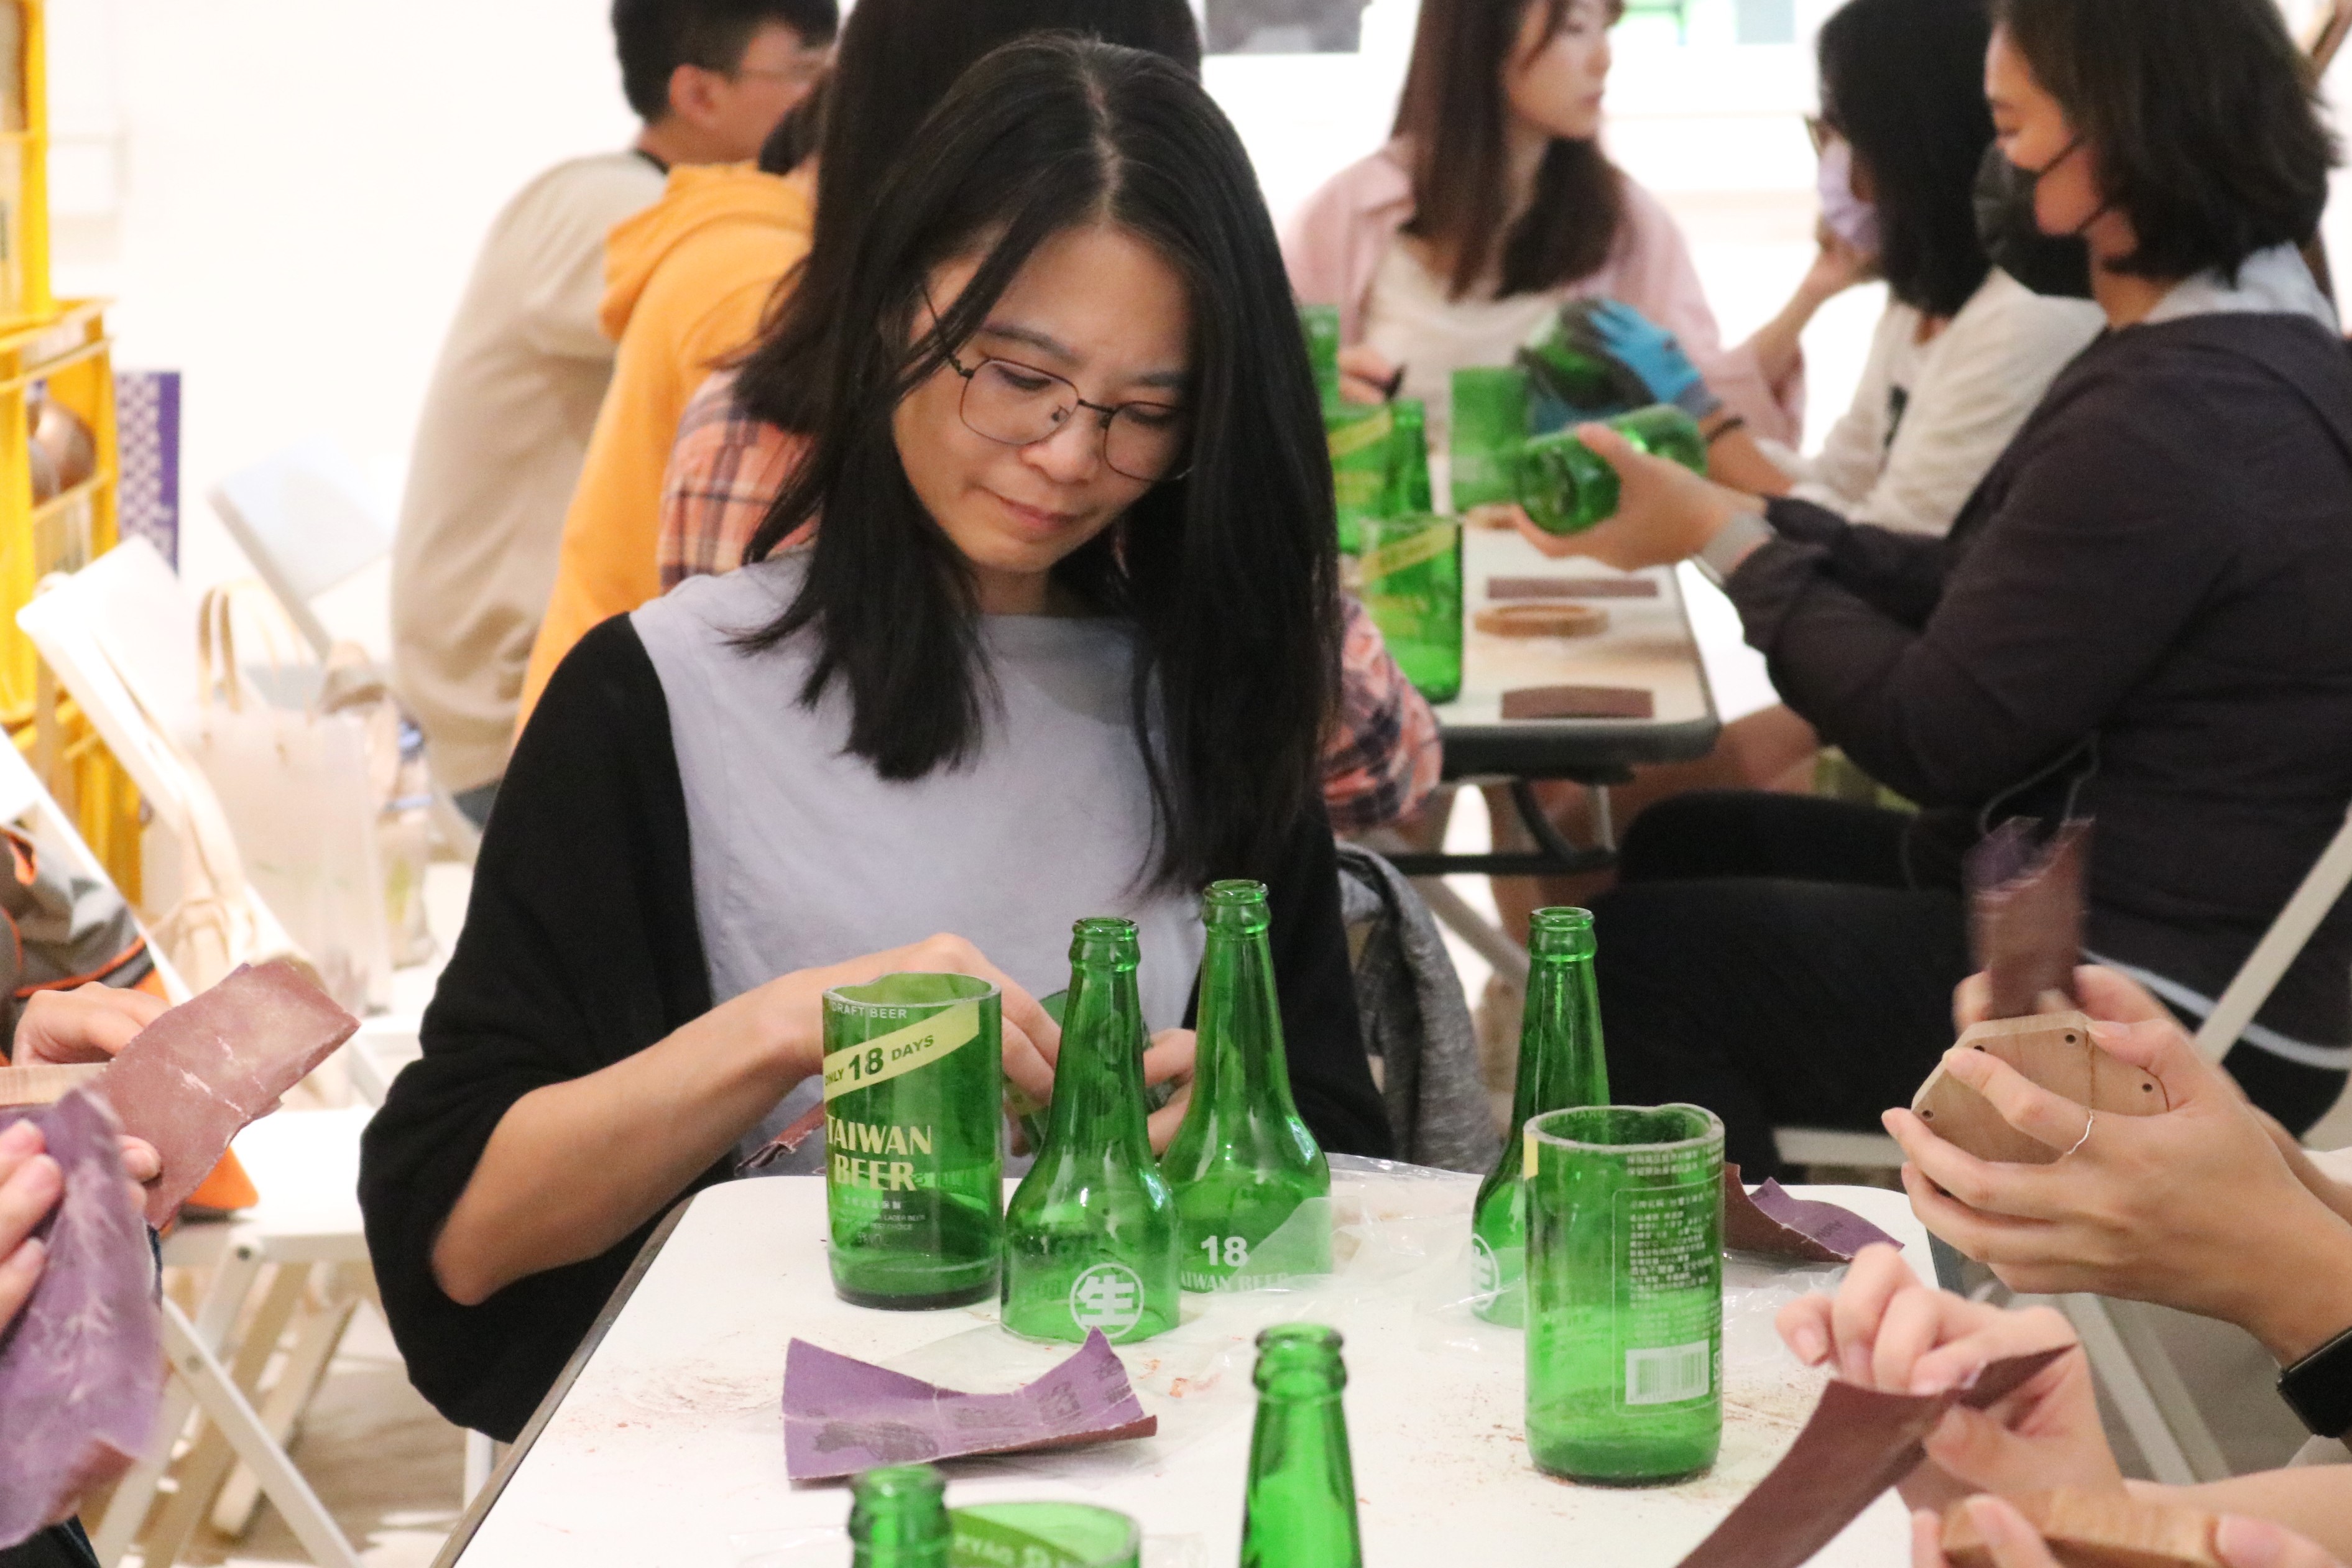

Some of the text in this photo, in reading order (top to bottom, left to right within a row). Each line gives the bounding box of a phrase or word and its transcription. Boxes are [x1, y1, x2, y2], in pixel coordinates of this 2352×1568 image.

[870, 1008, 908, 1019] BEER
[848, 1048, 884, 1081] 18
[891, 1035, 934, 1061] DAYS
[826, 1113, 931, 1156] TAIWAN
[834, 1153, 918, 1192] BEER
[1201, 1235, 1250, 1267] 18
[1077, 1275, 1135, 1327] 生
